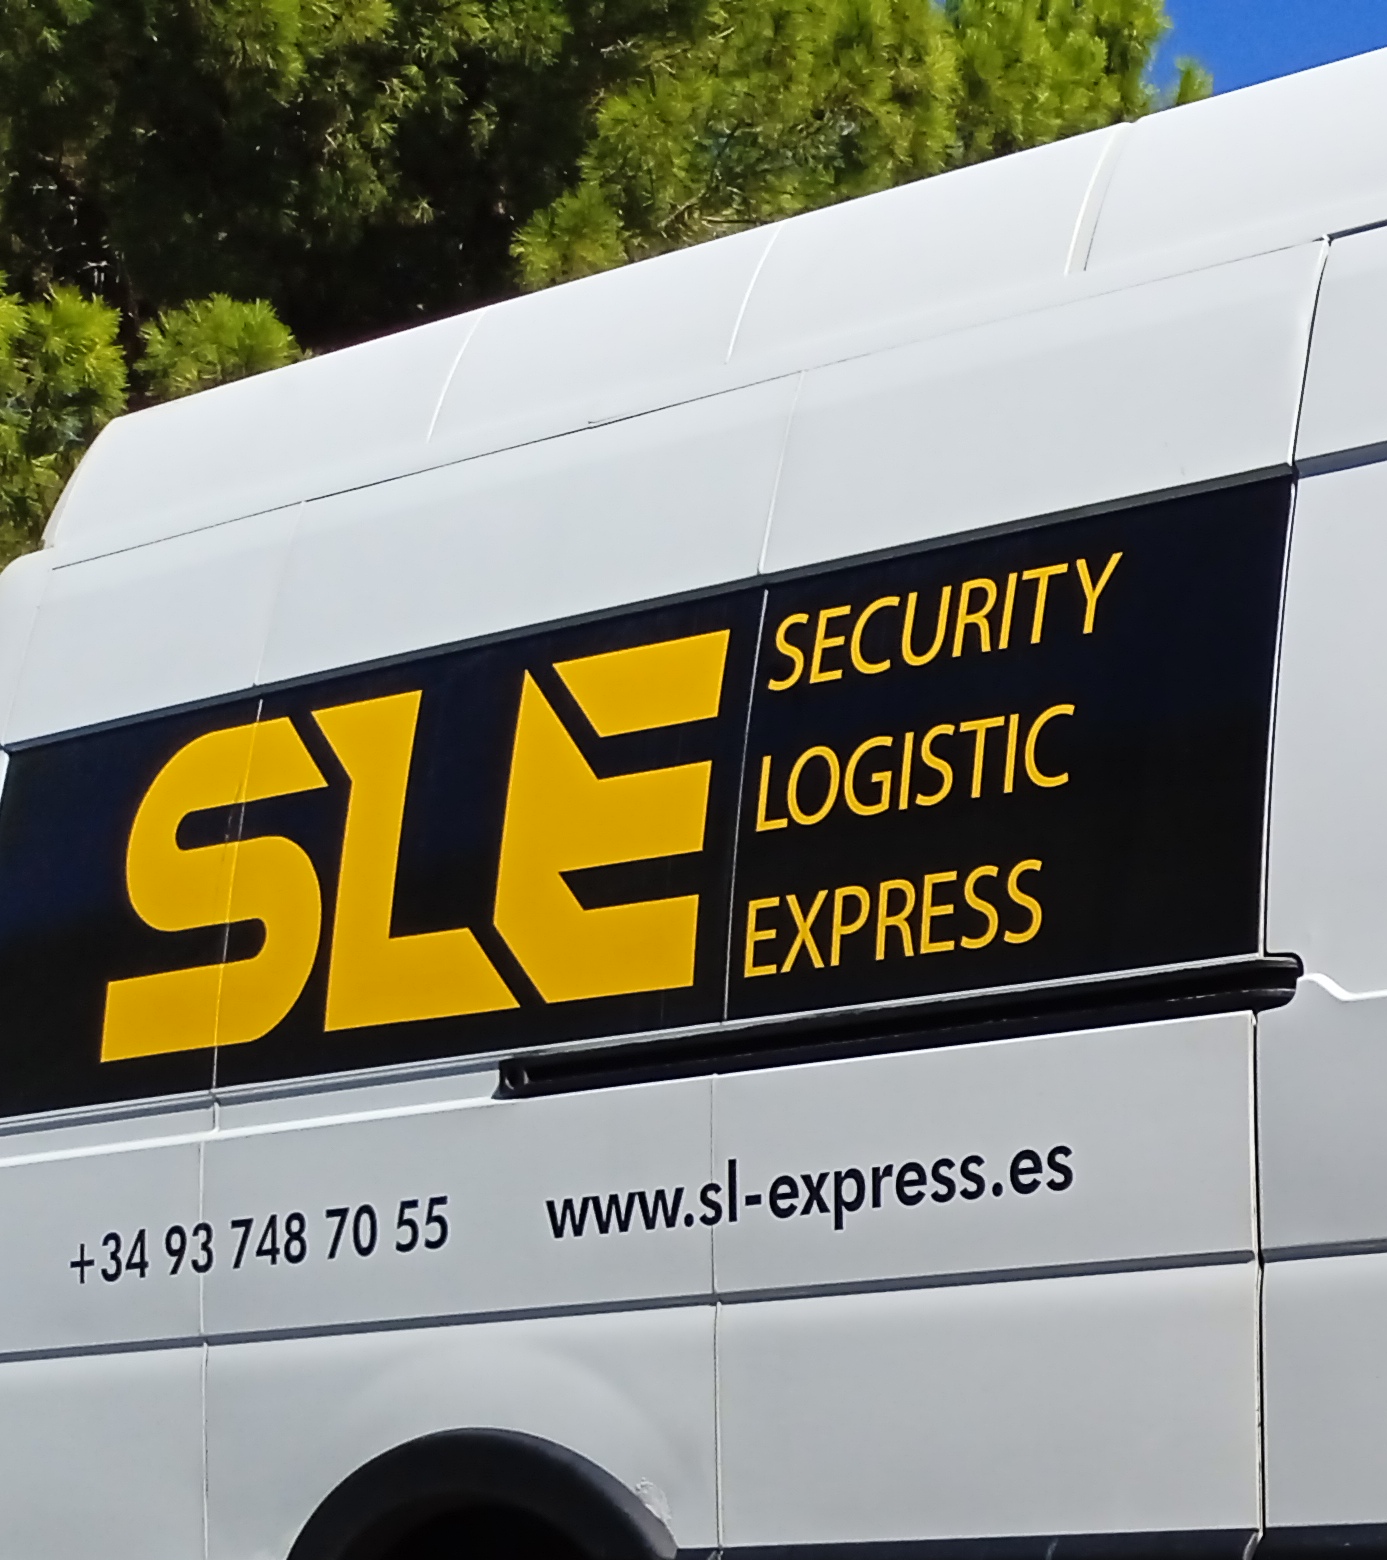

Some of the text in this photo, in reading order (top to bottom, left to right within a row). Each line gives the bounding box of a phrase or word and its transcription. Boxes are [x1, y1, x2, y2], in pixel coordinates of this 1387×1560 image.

[767, 551, 1123, 691] SECURITY
[755, 703, 1076, 832] LOGISTIC
[100, 628, 731, 1063] SLE
[743, 858, 1043, 978] EXPRESS
[70, 1195, 448, 1284] +34 93 748 70 55
[545, 1145, 1073, 1239] www.sl-express.es
